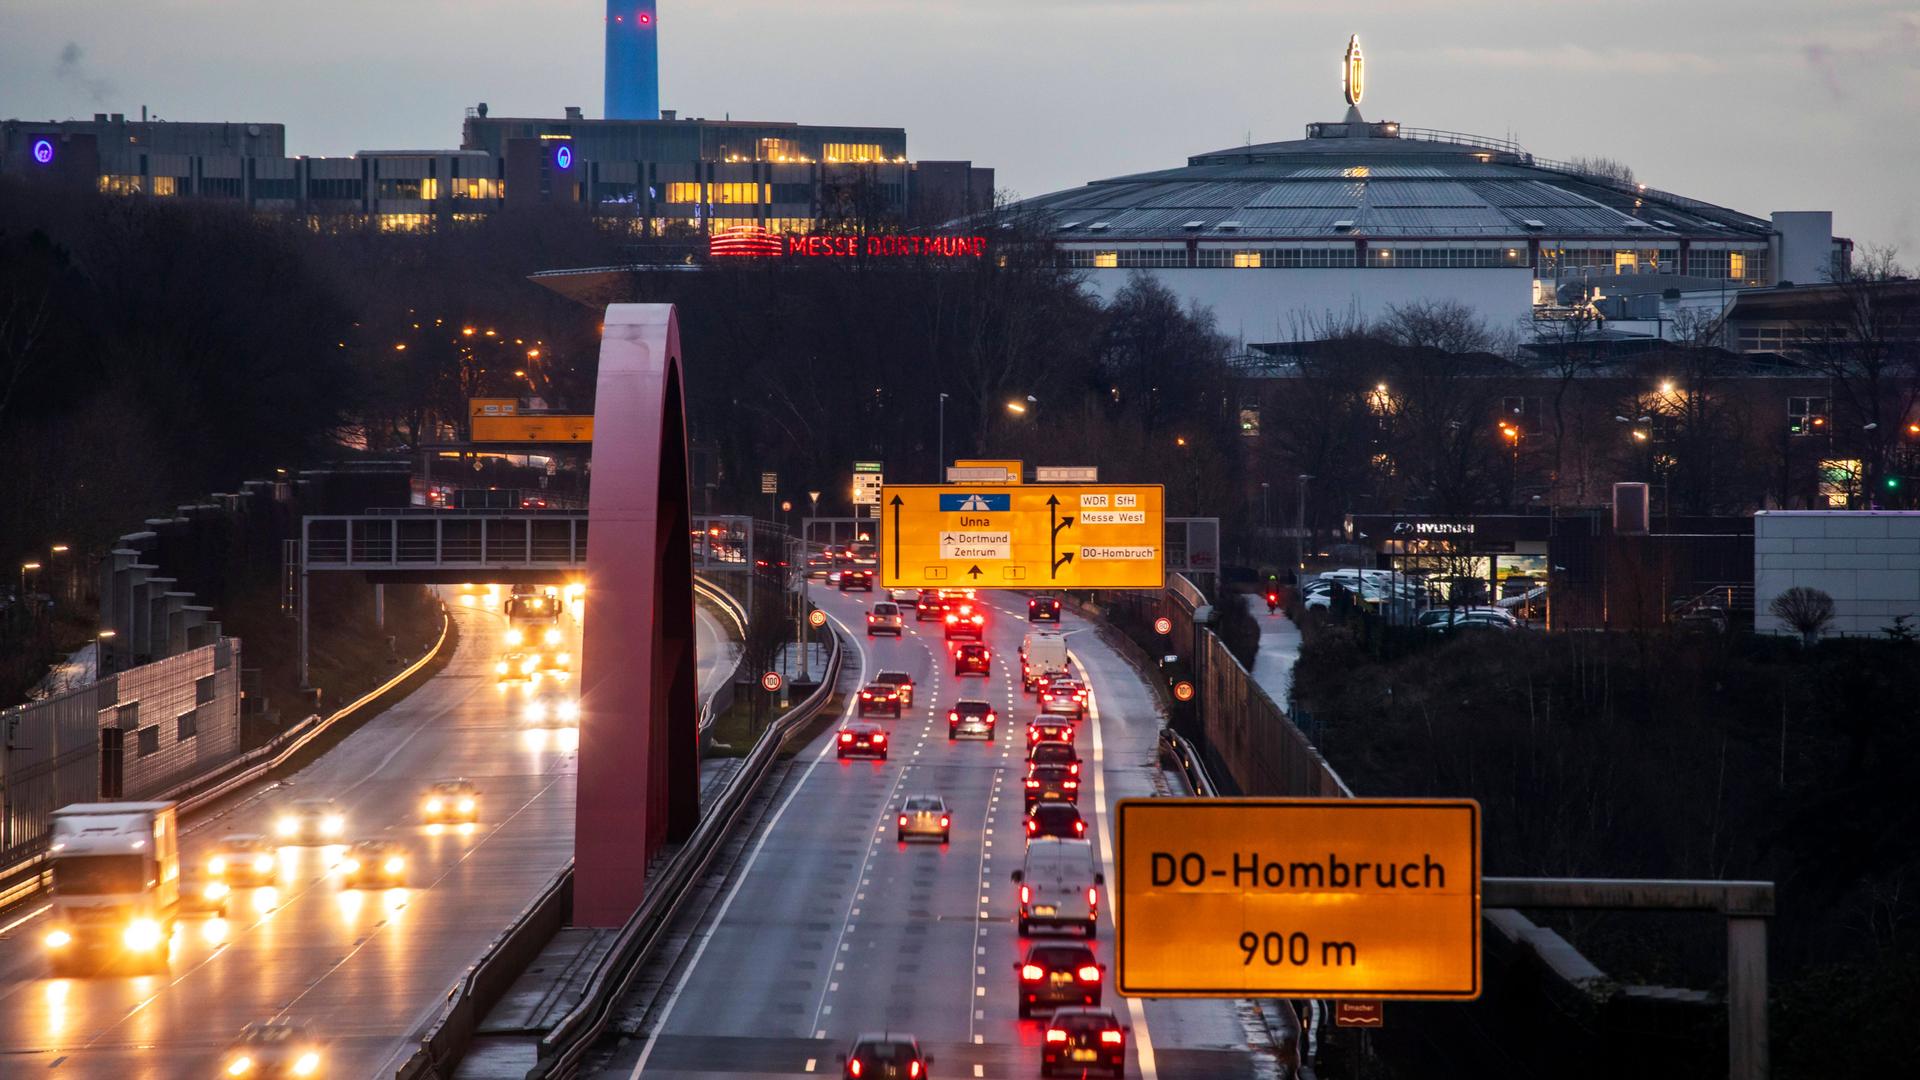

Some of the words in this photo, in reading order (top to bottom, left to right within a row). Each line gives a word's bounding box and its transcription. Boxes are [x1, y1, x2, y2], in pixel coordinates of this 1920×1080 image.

[789, 236, 858, 256] MESSE
[867, 236, 986, 257] DORTMUND
[1083, 496, 1107, 505] WDR
[1117, 496, 1134, 505] SfH
[960, 516, 990, 527] Unna
[1082, 513, 1114, 522] Messe
[1119, 513, 1143, 522] West
[959, 534, 1008, 543] Dortmund
[954, 547, 996, 556] Zentrum
[1082, 548, 1153, 558] DO-Hombruch
[813, 614, 822, 622] 80
[766, 677, 778, 686] 100
[1151, 852, 1446, 888] DO-Hombruch
[1239, 931, 1310, 967] 900
[1321, 940, 1357, 966] m
